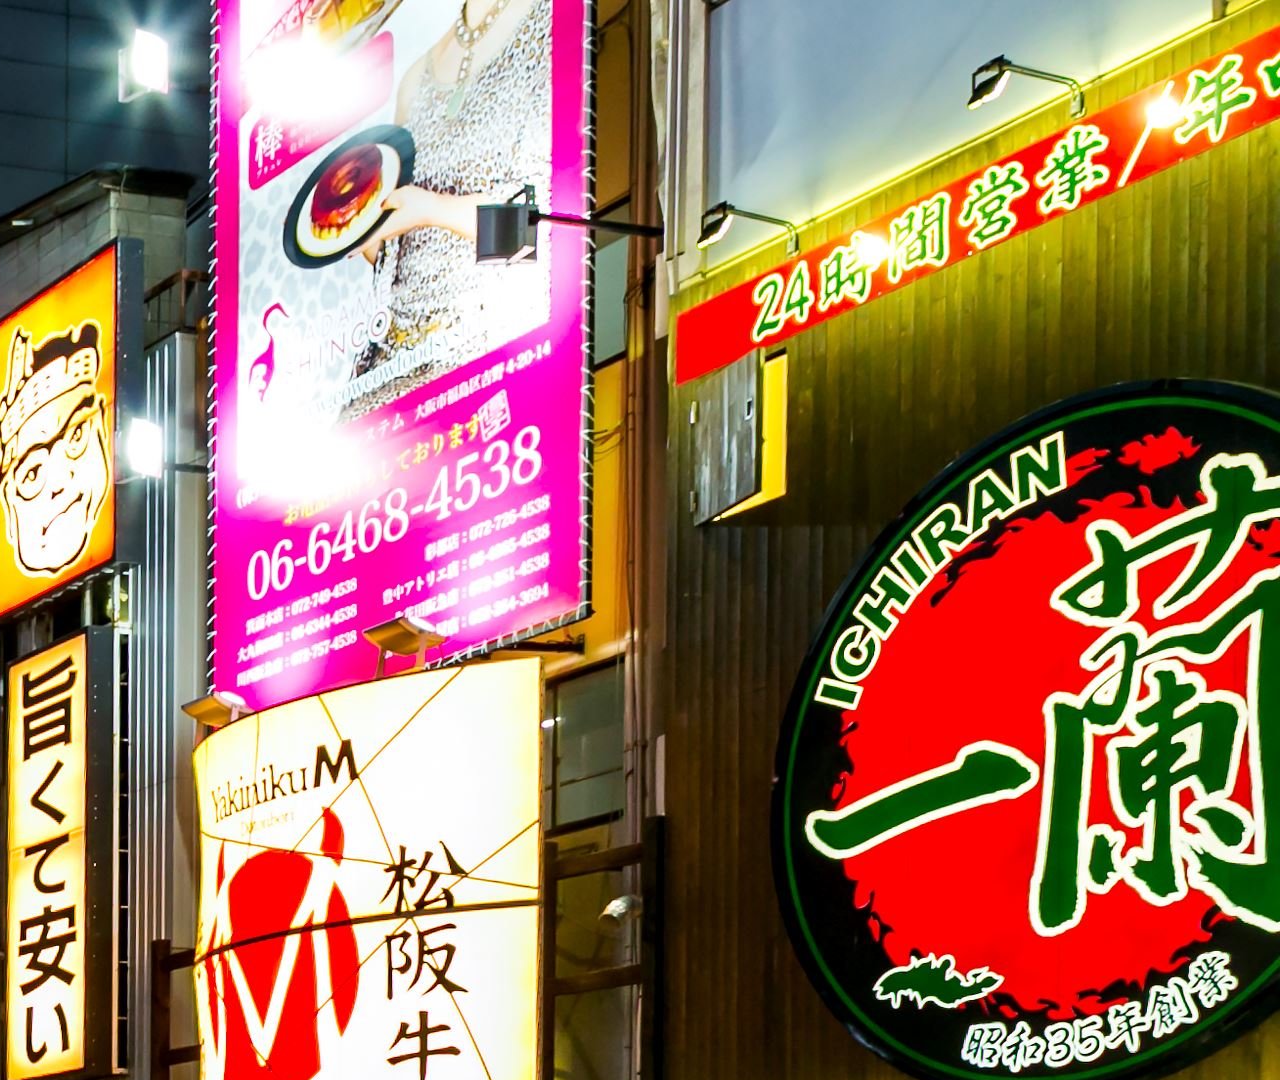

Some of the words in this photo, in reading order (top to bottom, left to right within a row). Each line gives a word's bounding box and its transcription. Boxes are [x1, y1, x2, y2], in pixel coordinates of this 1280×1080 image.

[247, 425, 543, 601] 06-6468-4538
[815, 430, 1067, 711] ICHIRAN
[211, 764, 309, 824] Yakiniku
[314, 739, 359, 787] M
[805, 452, 1280, 938] 一蘭
[19, 656, 77, 1063] 旨くて安い
[962, 951, 1238, 1071] 昭和35年創業
